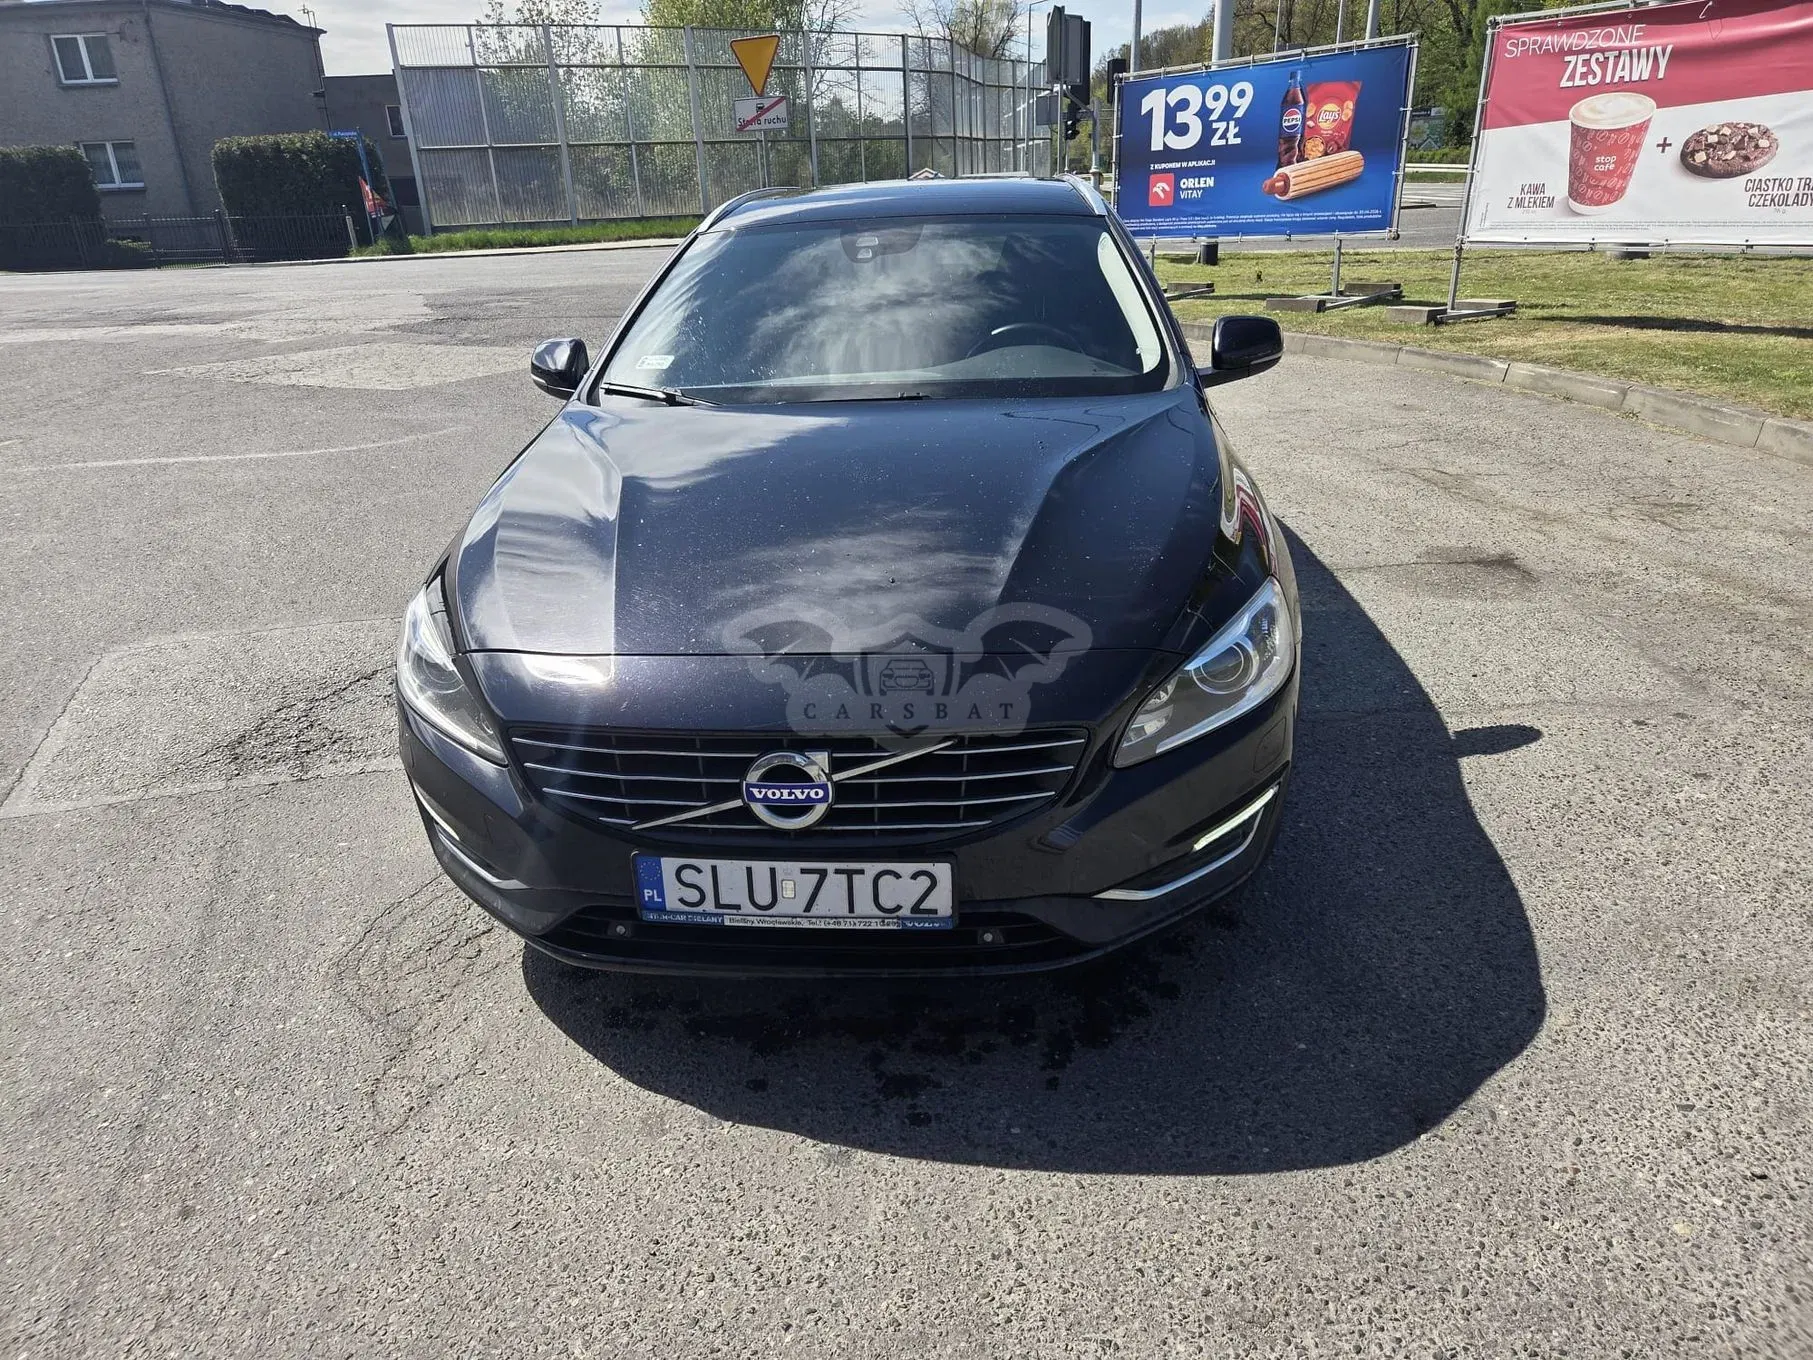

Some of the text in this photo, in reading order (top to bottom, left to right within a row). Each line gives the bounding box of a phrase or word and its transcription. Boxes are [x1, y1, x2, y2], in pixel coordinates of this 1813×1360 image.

[1504, 24, 1647, 58] SPRAWDZONE
[1559, 45, 1673, 88] ZESTAWY
[737, 115, 787, 127] Stfa ruchu
[1210, 120, 1242, 147] ZŁ
[1154, 161, 1180, 170] KUPONEM
[1188, 159, 1216, 168] APLIKACJI
[1595, 155, 1617, 164] stop
[1180, 176, 1215, 189] ORLEN
[1520, 182, 1546, 196] KAWA
[1744, 177, 1813, 192] CIASTKO TR
[1180, 189, 1203, 200] VITAY
[1507, 195, 1555, 209] Z MLEKIEM
[750, 786, 825, 800] VOLVO
[644, 888, 663, 903] PL
[674, 864, 939, 916] SLU 7TC2
